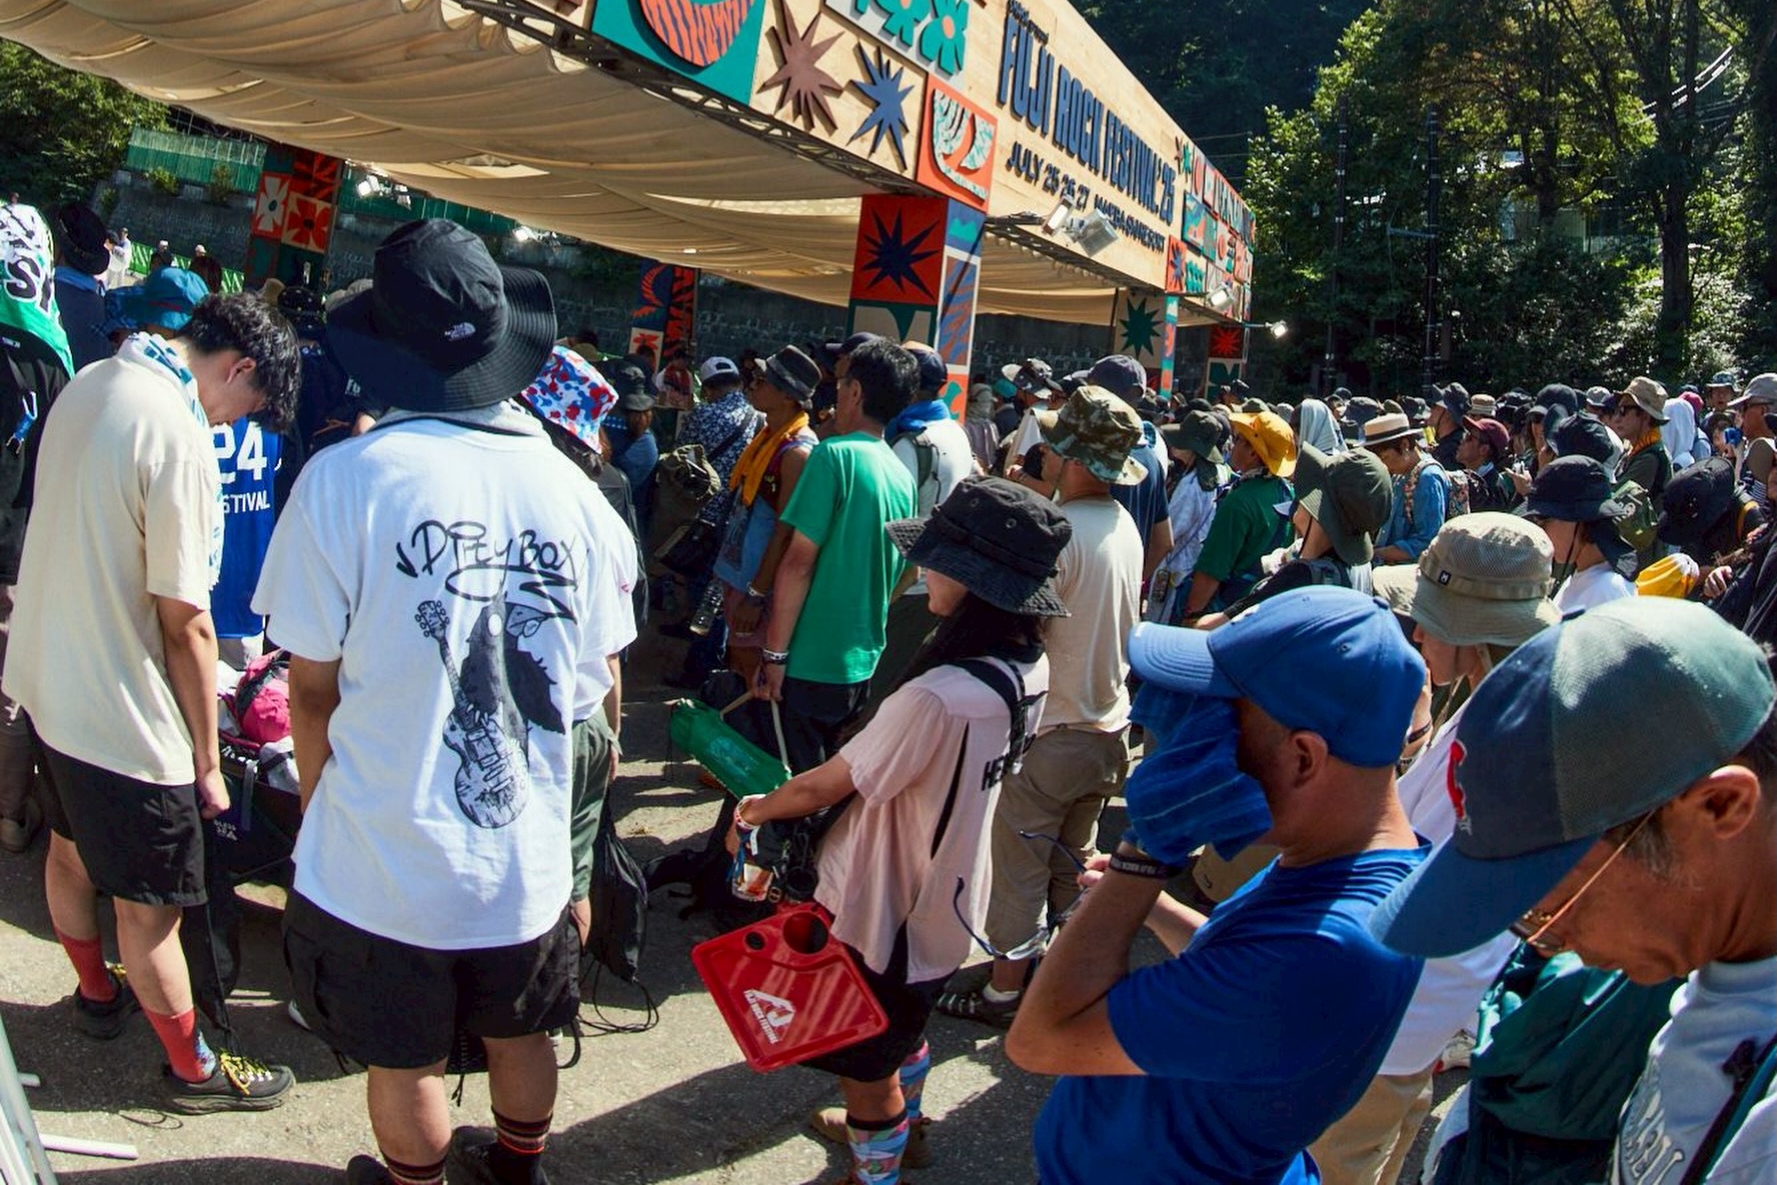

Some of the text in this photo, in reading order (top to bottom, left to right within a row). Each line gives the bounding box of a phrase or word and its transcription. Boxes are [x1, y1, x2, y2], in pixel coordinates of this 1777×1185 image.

[996, 13, 1055, 138] FUJI
[1053, 64, 1105, 176] ROCK
[1102, 109, 1159, 215] FESTIVAL
[1006, 141, 1044, 187] JULY
[222, 490, 271, 514] STIVAL
